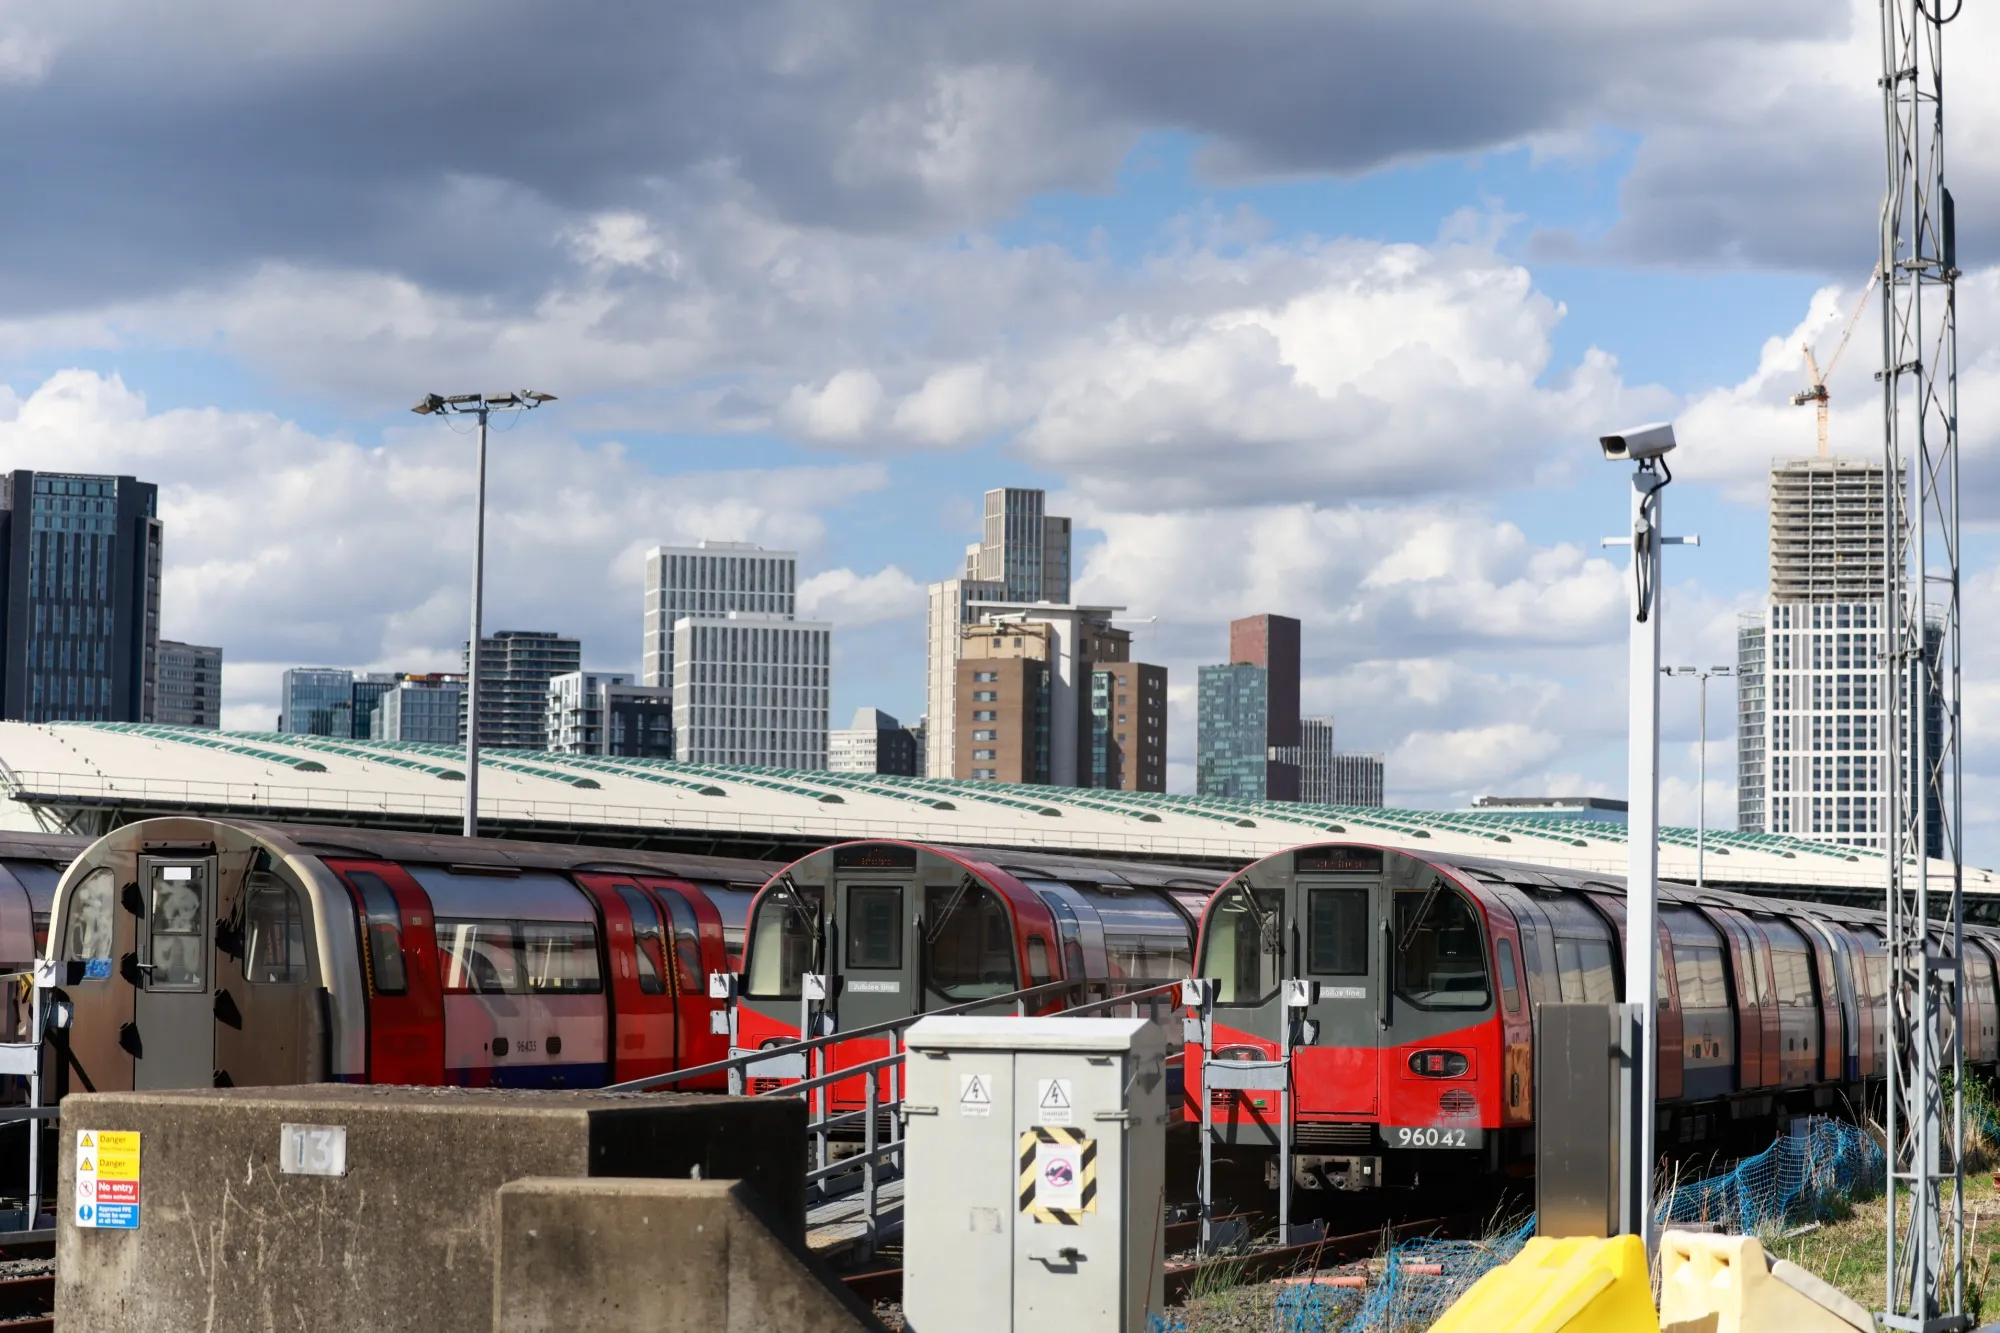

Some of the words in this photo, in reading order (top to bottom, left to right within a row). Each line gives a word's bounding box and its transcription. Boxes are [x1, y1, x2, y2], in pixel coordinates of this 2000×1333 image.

[853, 983, 879, 991] Jubilee
[881, 983, 895, 991] line
[516, 1040, 537, 1053] 96435
[99, 1135, 126, 1144] Danger
[1398, 1127, 1466, 1147] 96042
[293, 1131, 332, 1170] 13
[99, 1159, 126, 1168] Danger
[98, 1182, 110, 1192] No
[112, 1183, 134, 1194] entry
